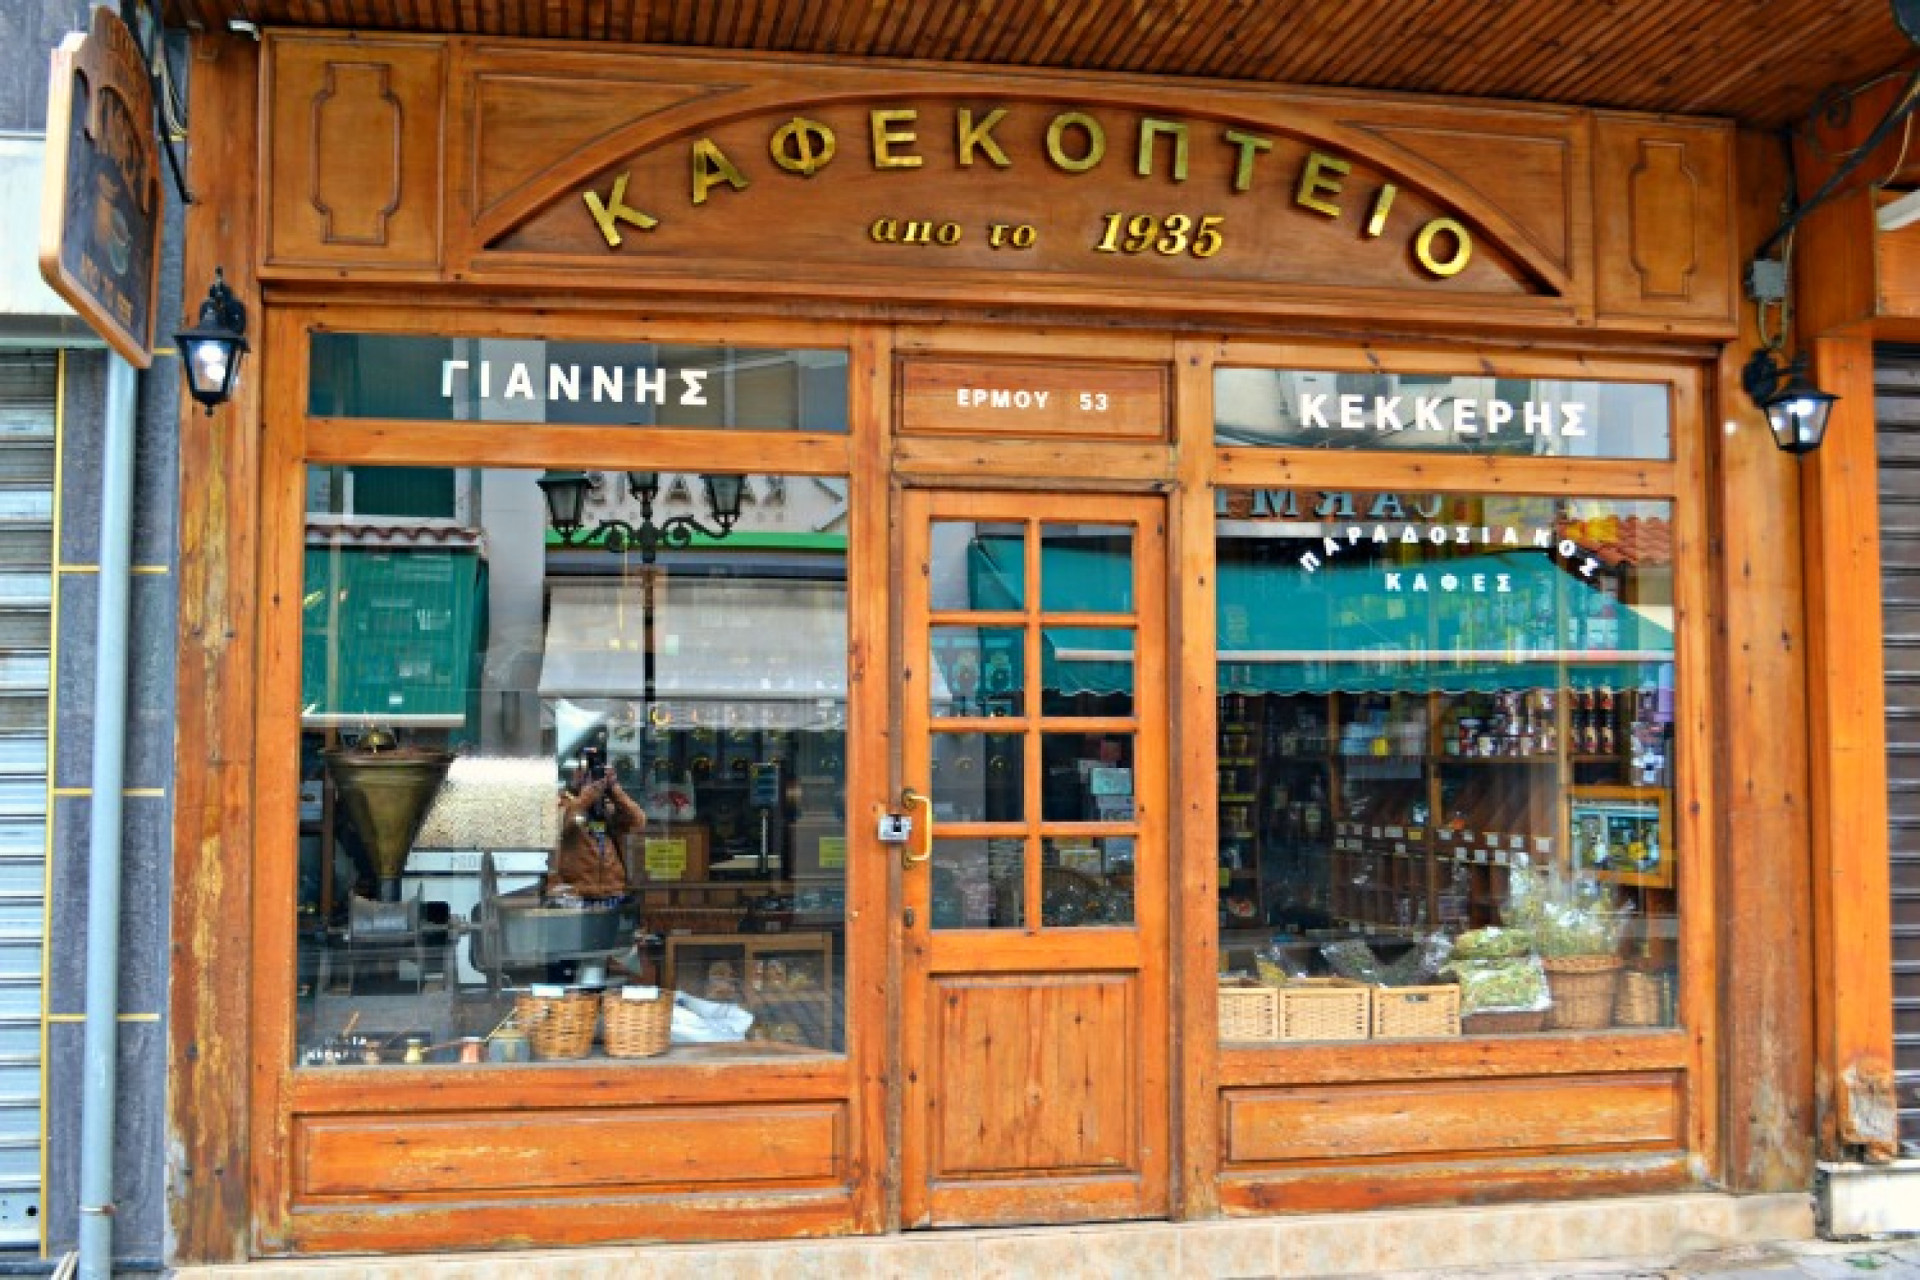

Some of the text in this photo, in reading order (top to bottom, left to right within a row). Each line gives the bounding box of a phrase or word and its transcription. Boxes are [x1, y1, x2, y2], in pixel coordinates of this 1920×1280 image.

[582, 107, 1473, 278] ΚΑΦΕΚΟΠΤΕΙΟ
[989, 221, 1038, 249] το
[1097, 211, 1225, 258] 1935
[441, 359, 708, 406] ΓΙΑΝΝΗΣ
[956, 387, 1109, 411] ΕΡΜΟΥ 53
[1298, 391, 1588, 438] ΚΕΚΚΕΡΗΣ
[1298, 523, 1600, 578] ΠΑΡΑΔΟΣΙΑΝΟΣ
[1384, 571, 1513, 592] ΚΑΦΕΣ
